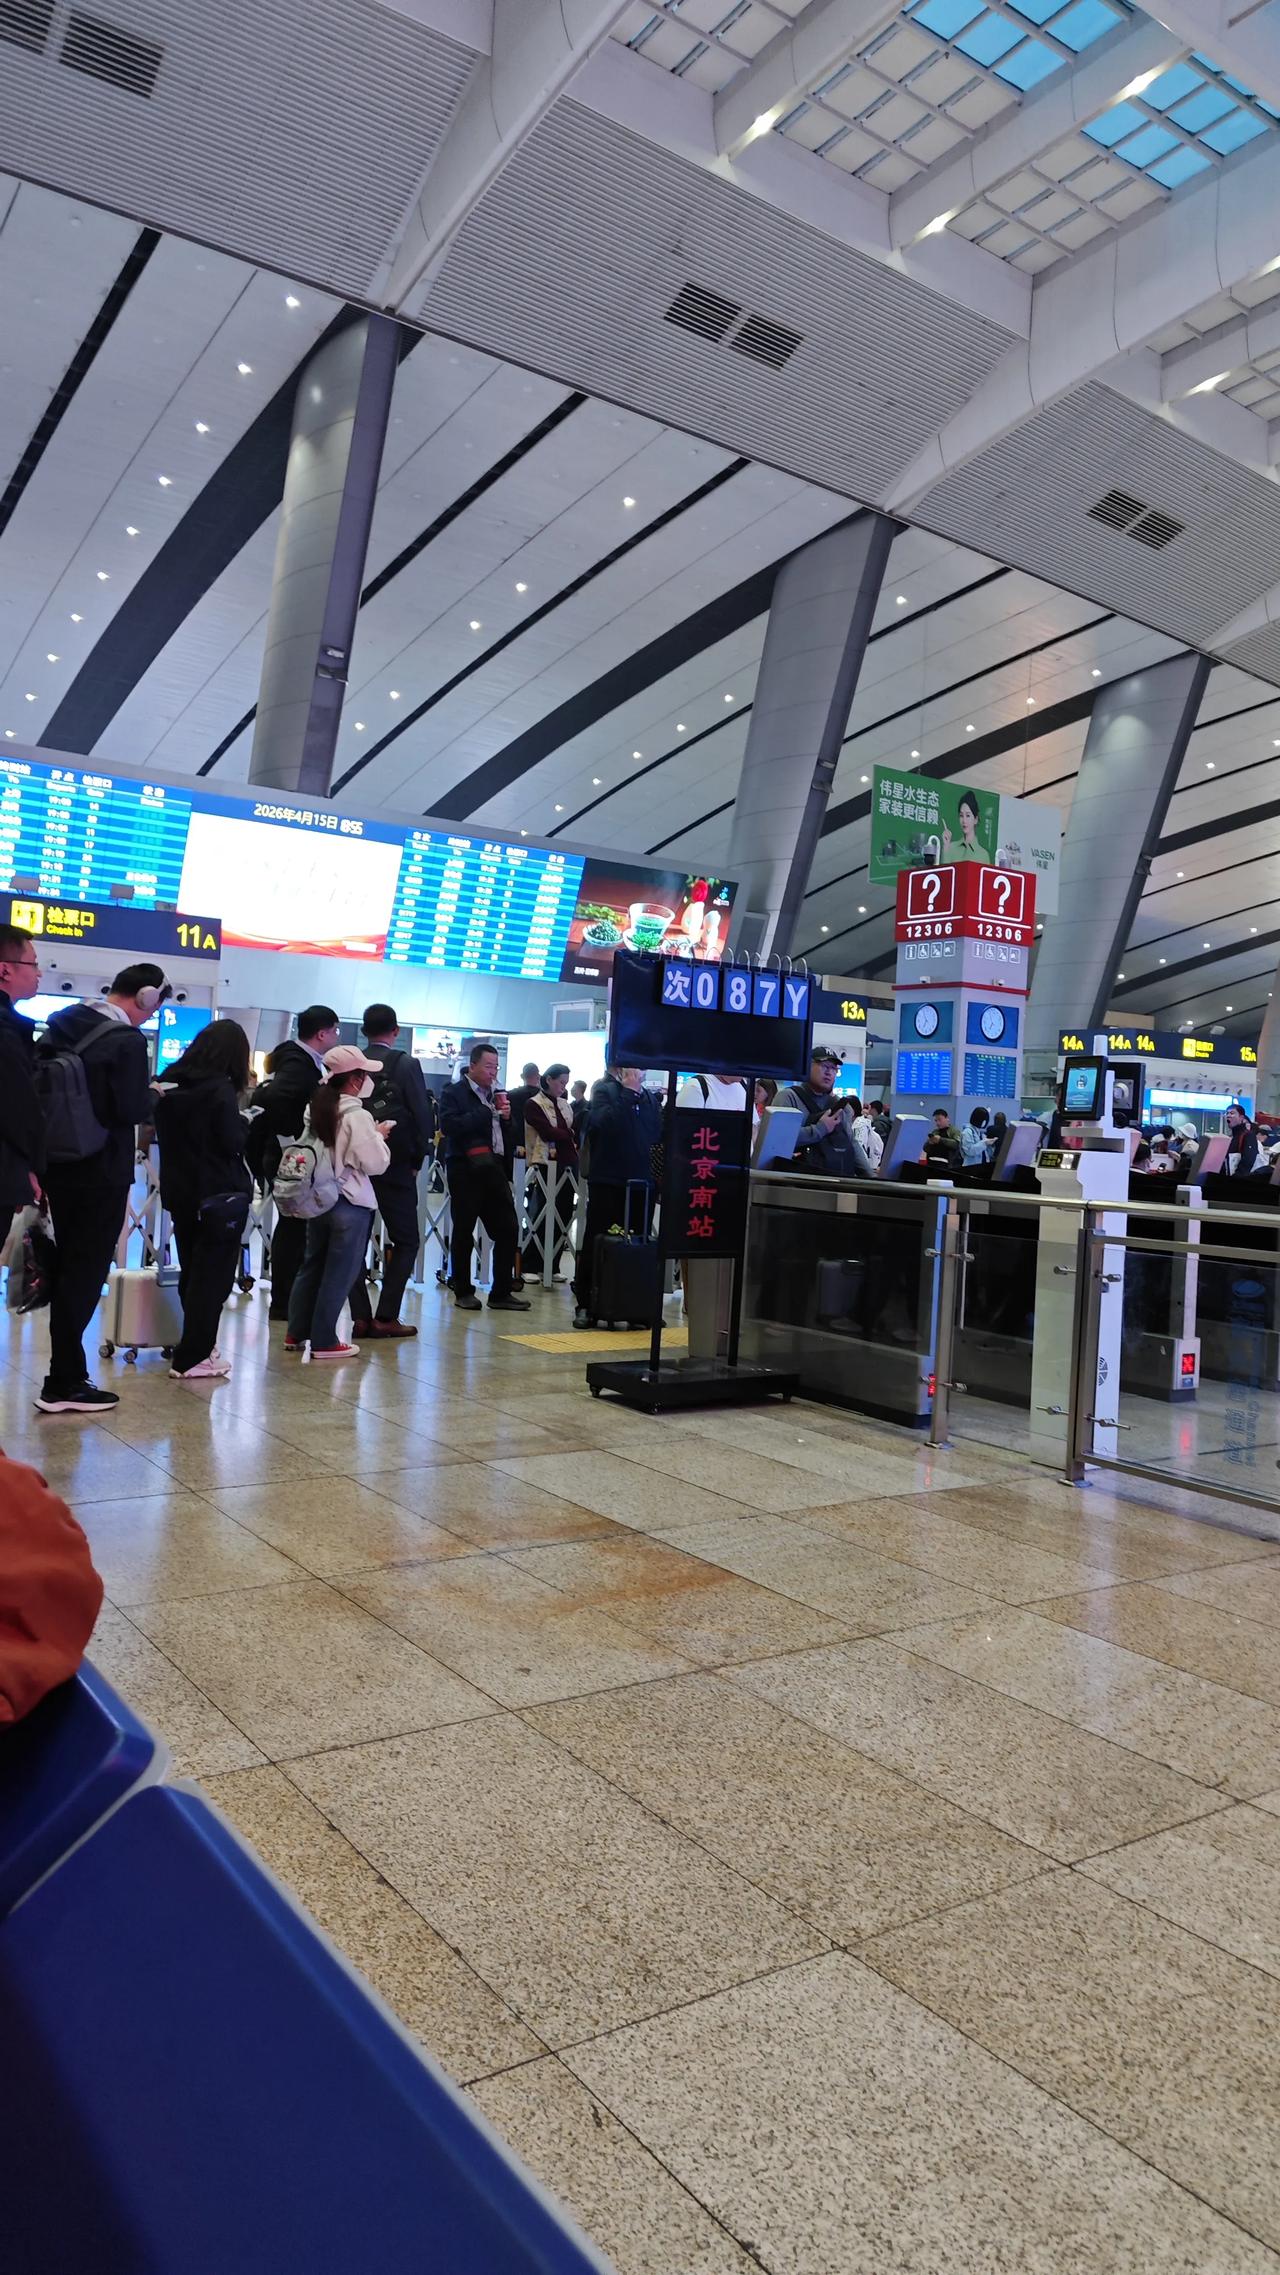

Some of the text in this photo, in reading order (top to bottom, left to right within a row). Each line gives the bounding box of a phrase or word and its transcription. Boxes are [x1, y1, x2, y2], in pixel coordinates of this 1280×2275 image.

[880, 780, 939, 807] 伟星水生态
[254, 803, 338, 830] 2026年4月15日
[879, 798, 938, 825] 家装更信赖
[1031, 848, 1055, 861] VASEN
[47, 906, 95, 927] 检票口
[177, 923, 217, 950] 11A
[906, 922, 953, 938] 12306
[978, 923, 1022, 942] 12306
[840, 1000, 865, 1020] 13A
[1061, 1035, 1084, 1051] 14A
[1108, 1034, 1132, 1050] 14A
[1136, 1035, 1155, 1052] 14A
[1240, 1046, 1257, 1063] 15A
[686, 1127, 720, 1237] 北京南站
